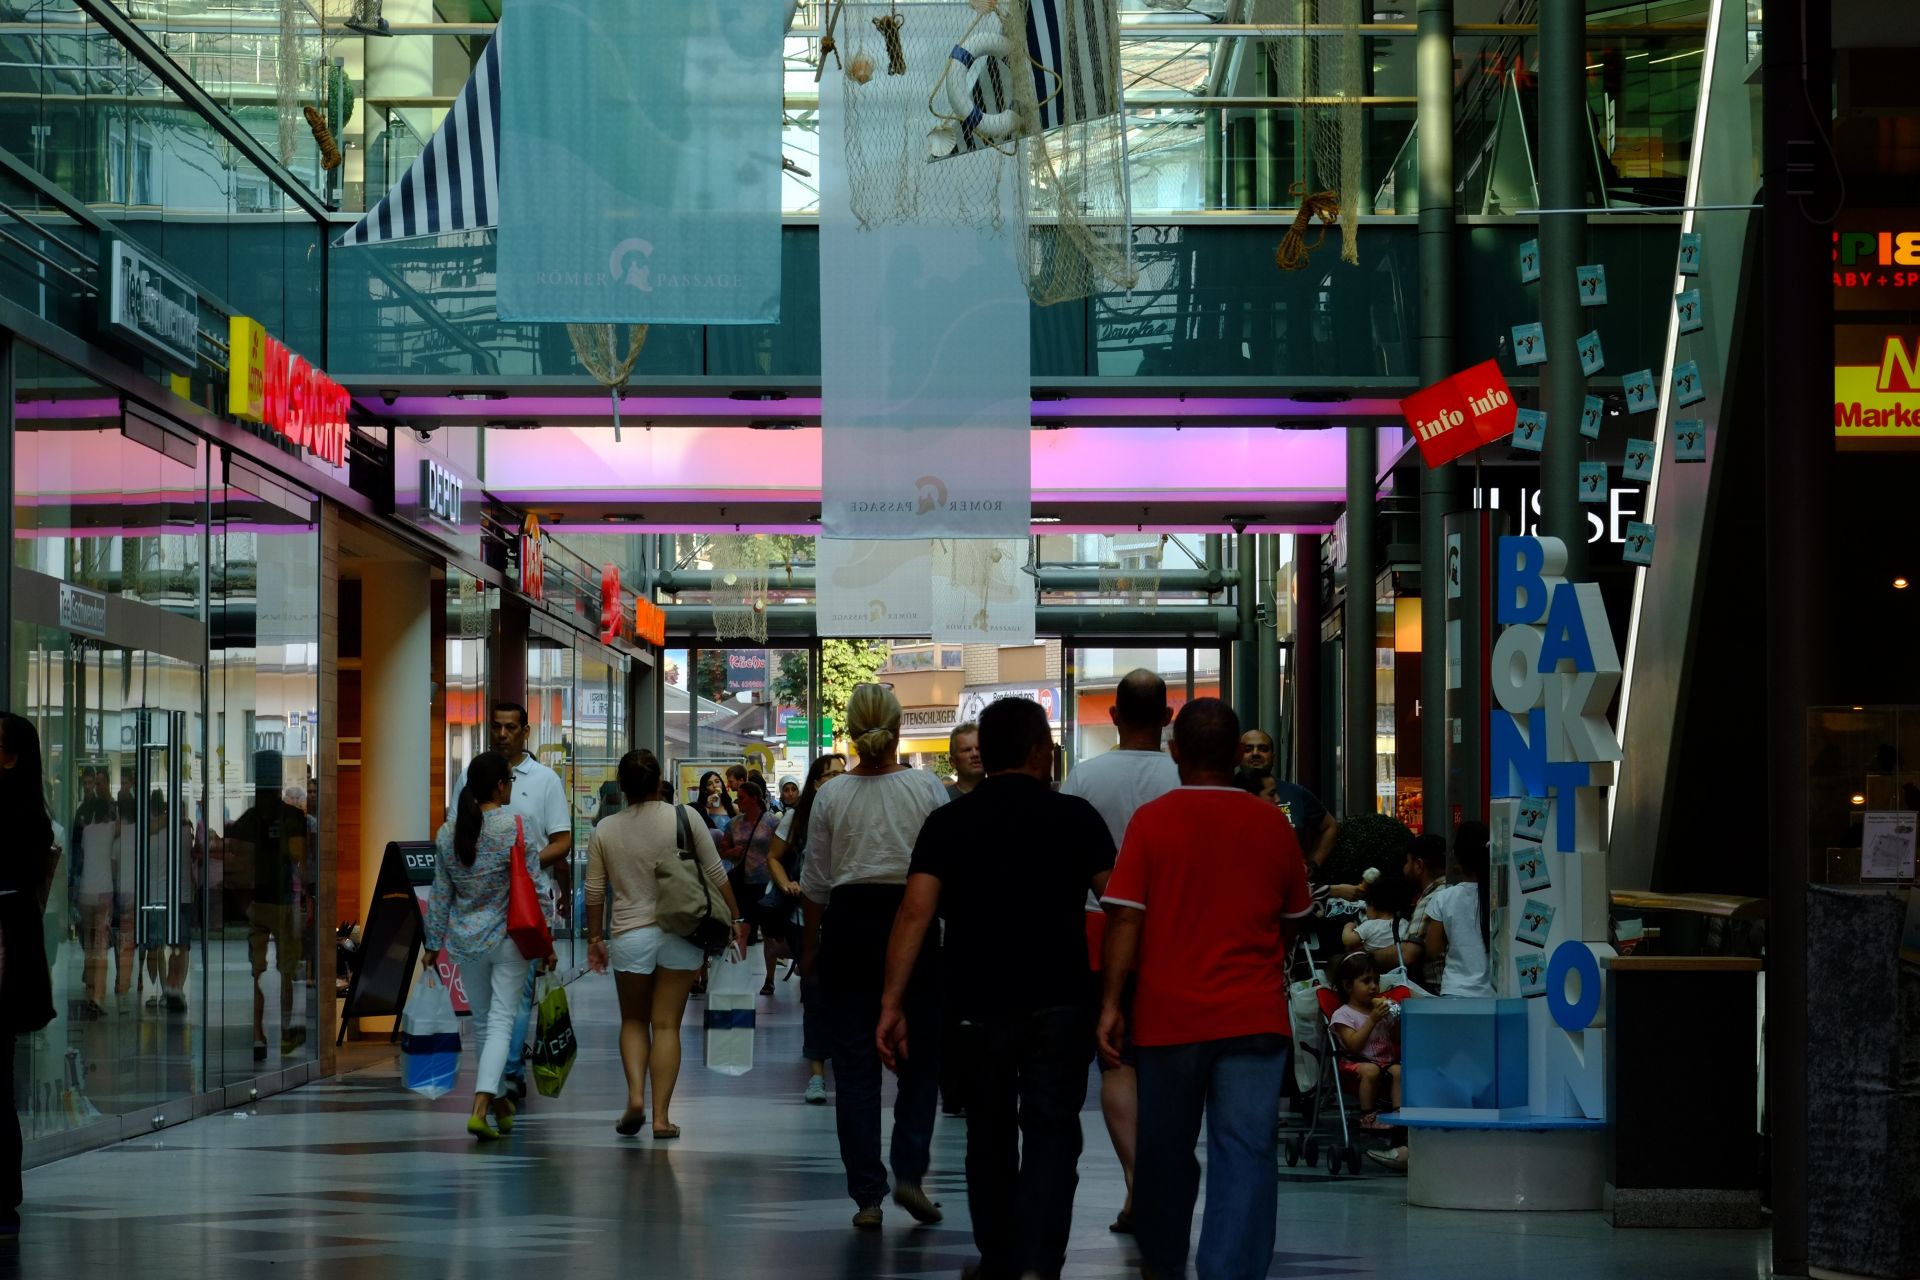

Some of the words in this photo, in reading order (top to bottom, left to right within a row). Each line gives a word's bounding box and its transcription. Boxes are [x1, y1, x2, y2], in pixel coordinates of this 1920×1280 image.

[1833, 231, 1920, 266] PIE
[656, 273, 743, 287] PASSAGE
[1102, 321, 1168, 343] Douglas
[1416, 409, 1464, 441] info
[1468, 388, 1508, 417] info
[428, 459, 463, 526] DEPOT
[406, 854, 437, 868] DEP
